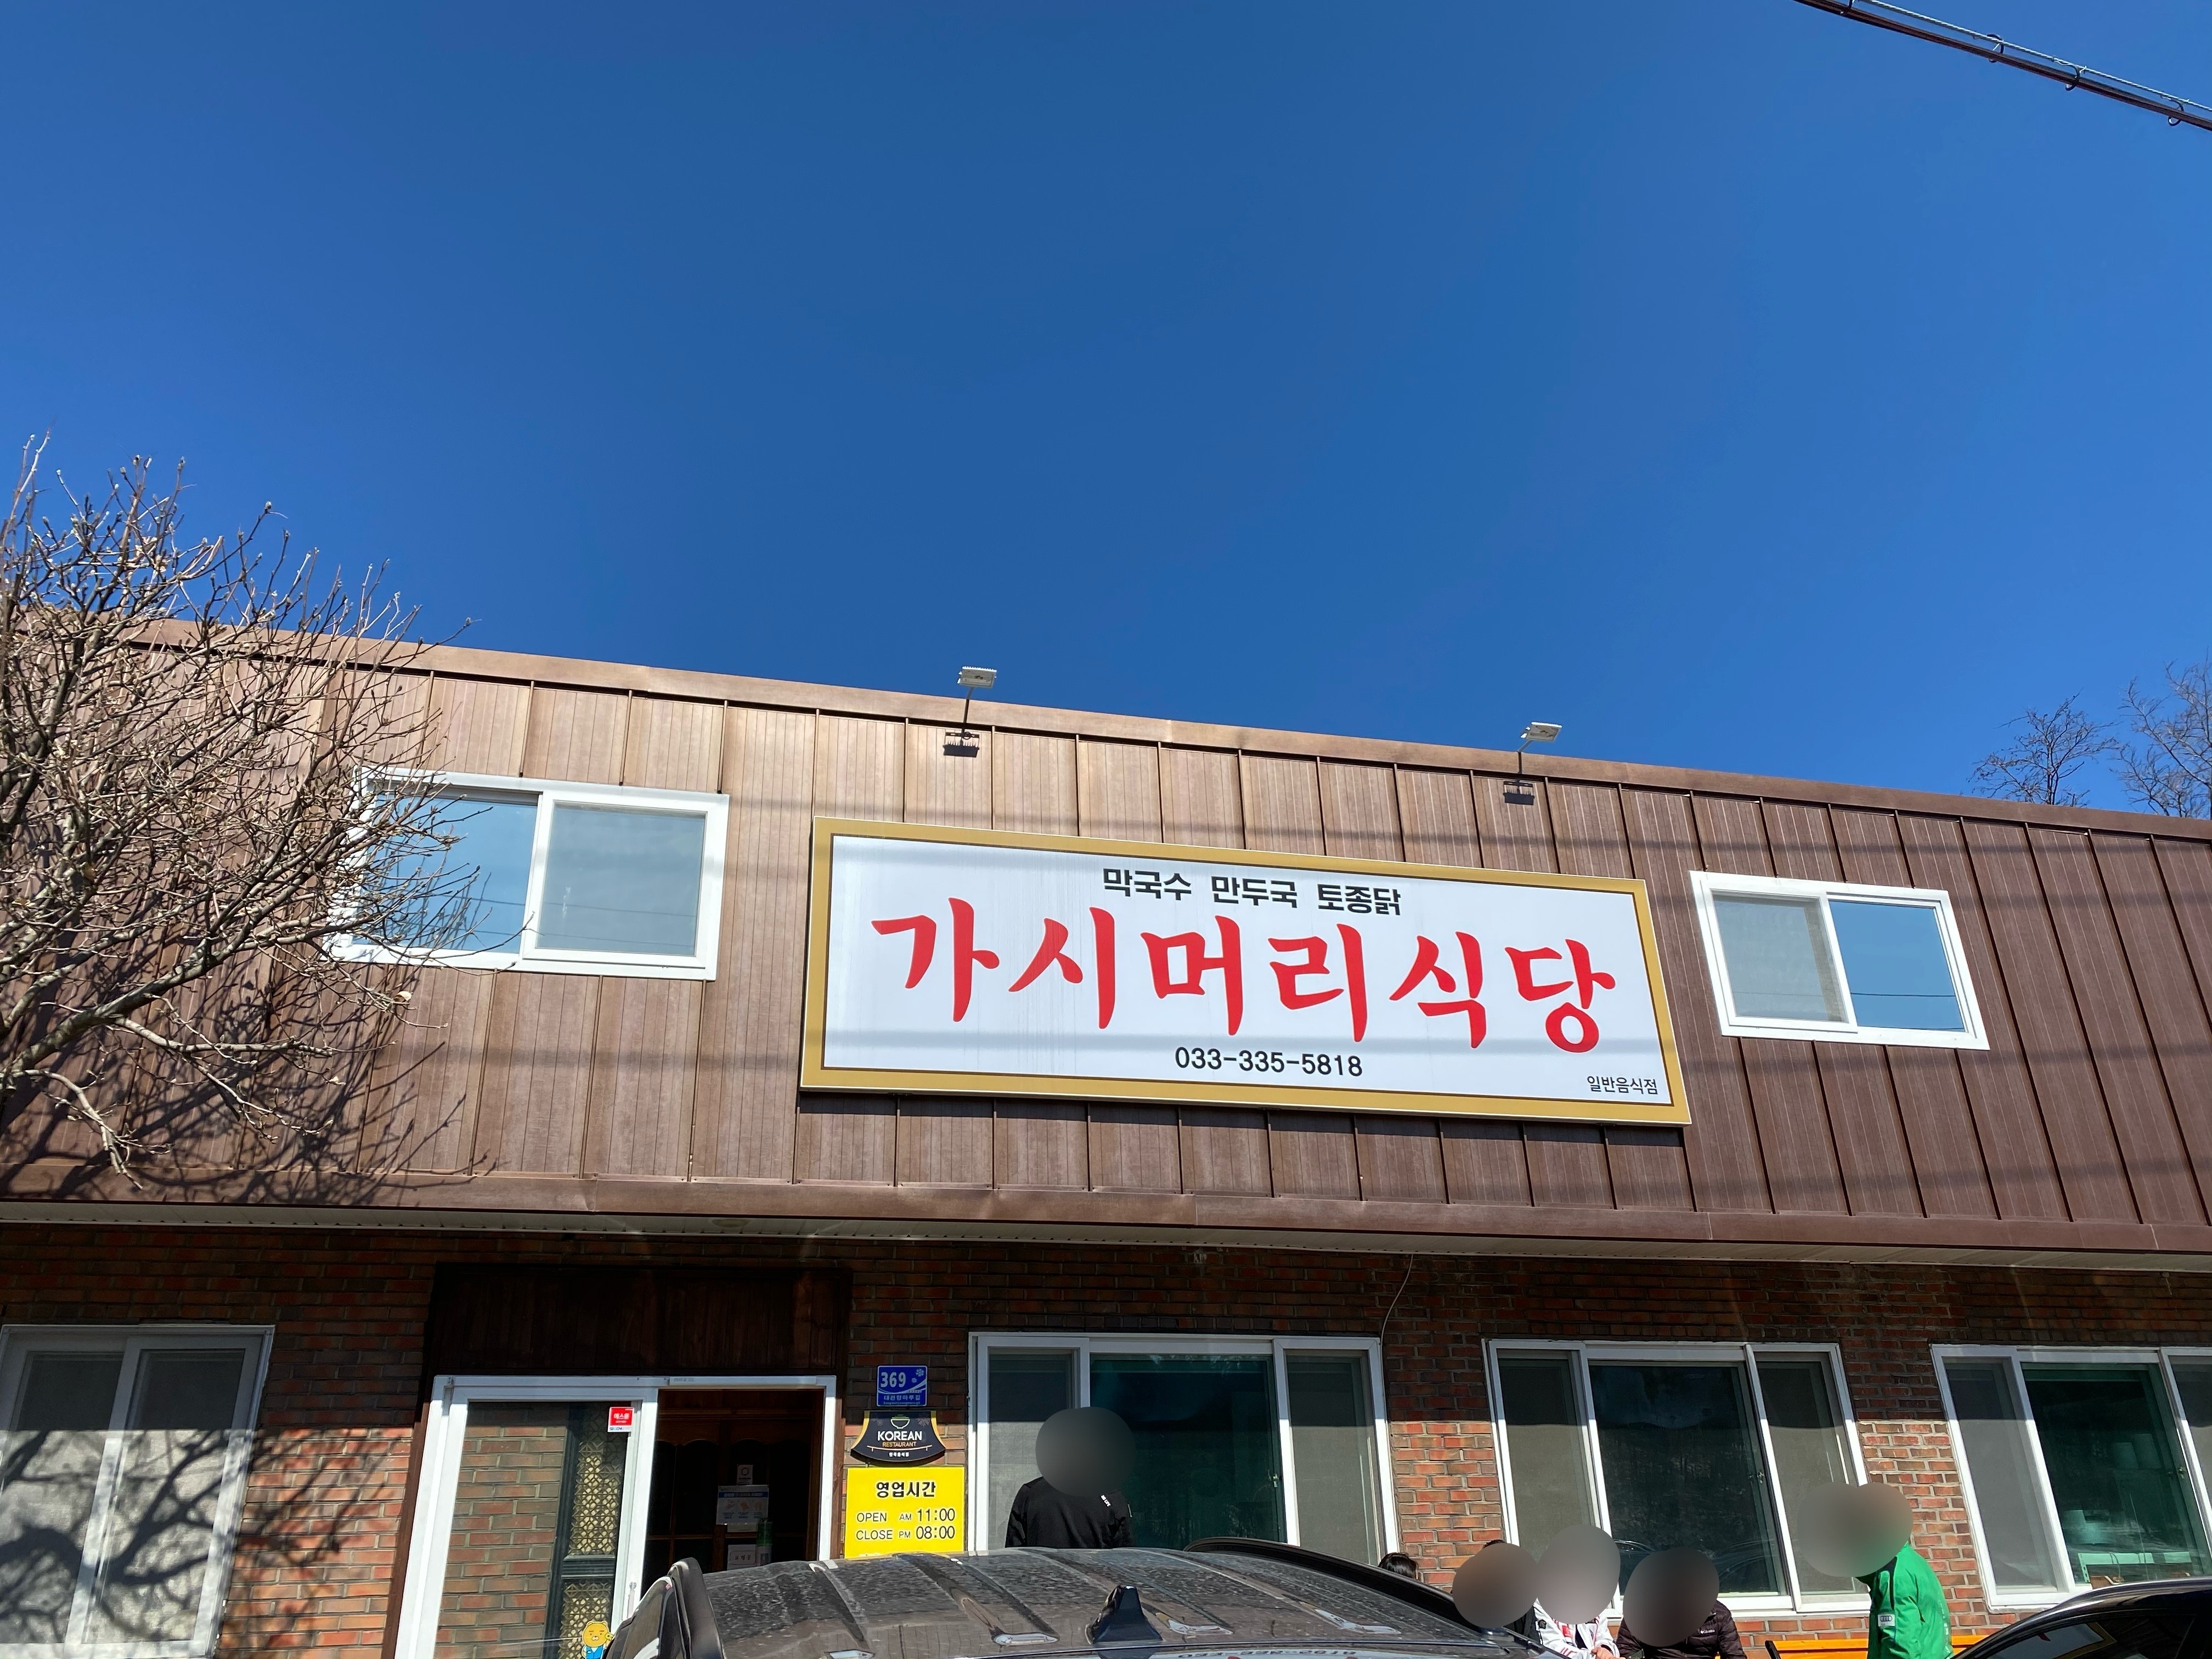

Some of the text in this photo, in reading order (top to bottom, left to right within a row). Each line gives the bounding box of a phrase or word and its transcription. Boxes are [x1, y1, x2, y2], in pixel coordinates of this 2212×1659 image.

[1103, 868, 1402, 916] 막국수 만두국 토종닭
[871, 897, 1616, 1053] 가시머리식당
[1175, 1046, 1363, 1077] 033-335-5818
[1587, 1075, 1658, 1096] 일반음식점
[881, 1372, 906, 1387] 369
[878, 1431, 922, 1441] KOREAN
[876, 1482, 935, 1498] 영업시간
[856, 1513, 887, 1522] OPEN
[917, 1508, 955, 1522] 11:00
[856, 1530, 893, 1540] CLOSE
[916, 1526, 955, 1539] 08:00
